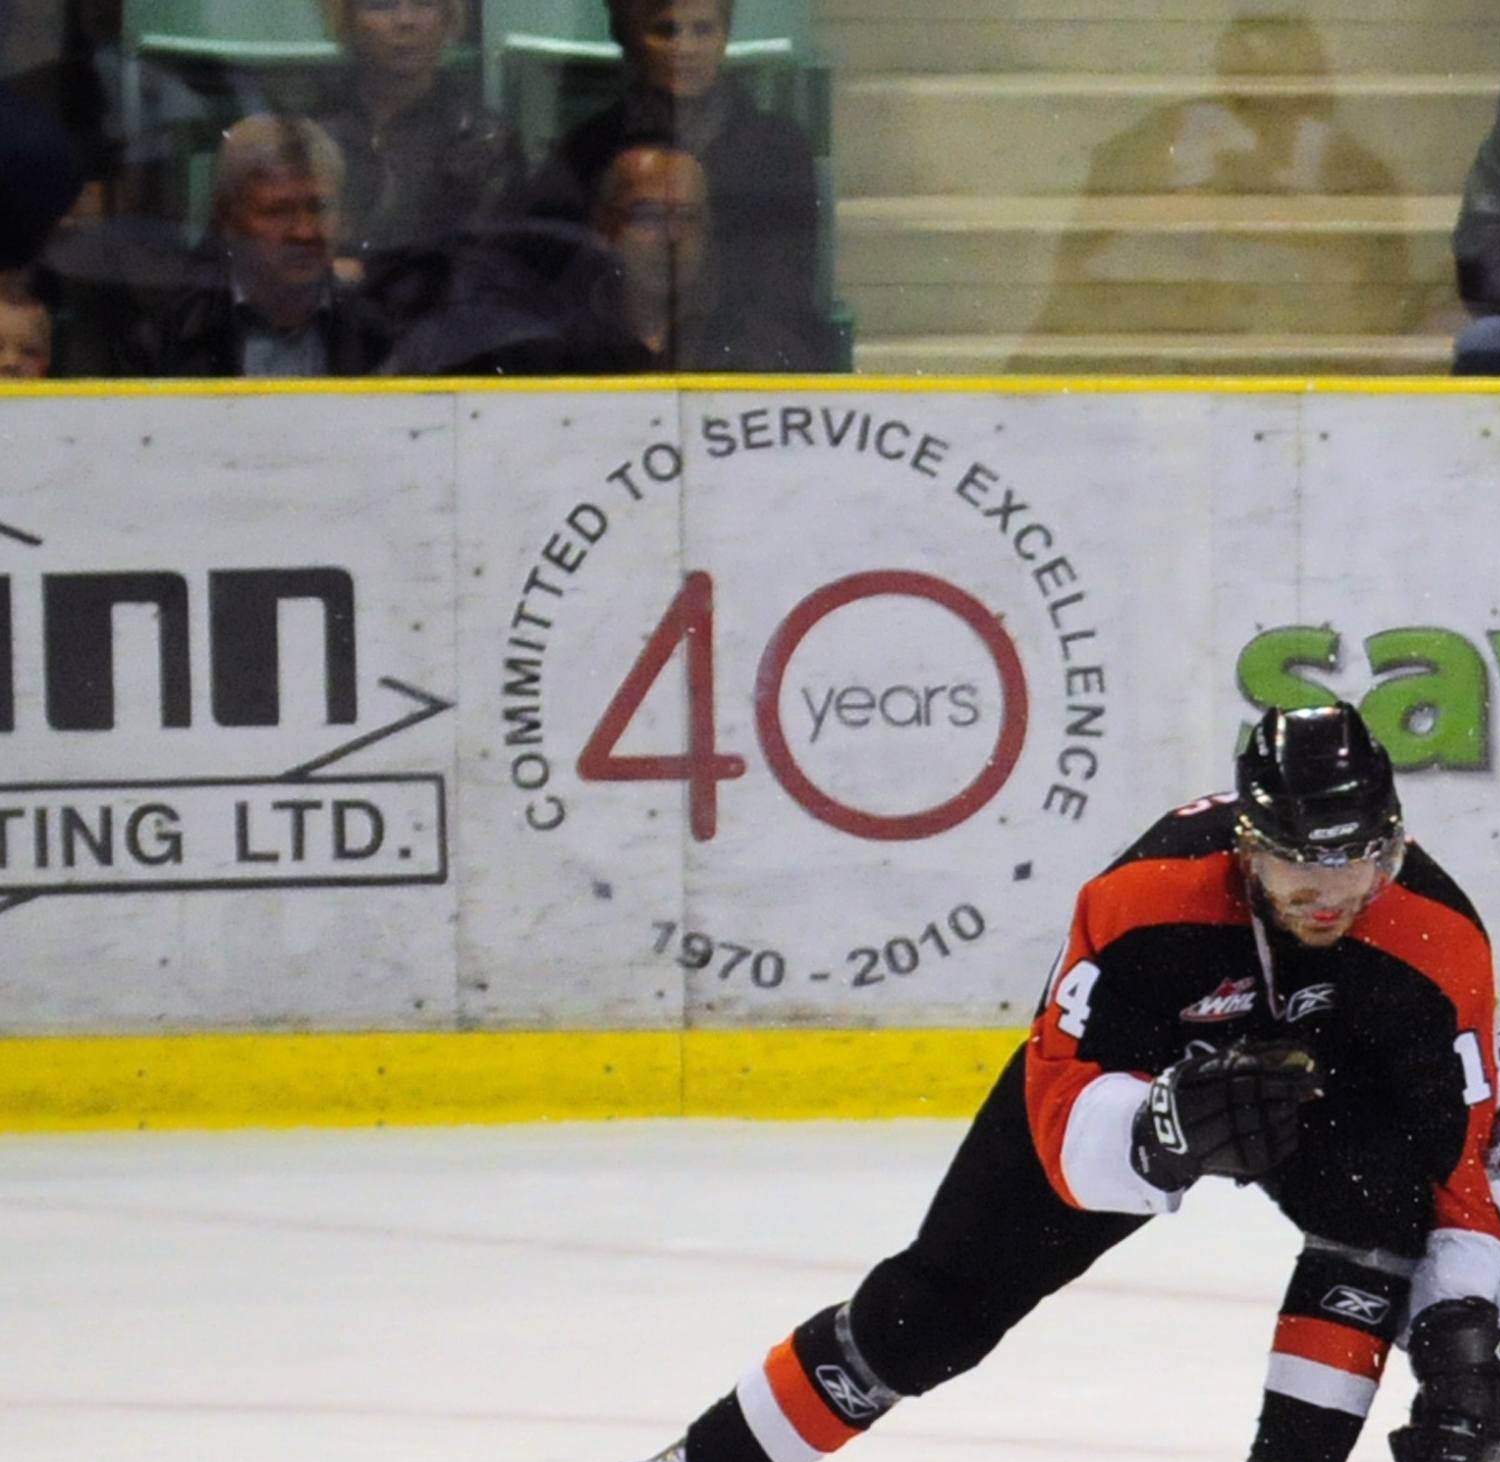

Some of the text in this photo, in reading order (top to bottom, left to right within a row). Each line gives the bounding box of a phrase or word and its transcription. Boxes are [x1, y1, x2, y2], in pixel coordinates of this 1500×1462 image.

[0, 567, 358, 733] nn
[502, 407, 1108, 834] COMMITTED TO SERVICE EXCELLENCE
[576, 569, 1030, 843] 40
[801, 684, 980, 744] years
[235, 800, 413, 863] LTD.
[650, 920, 786, 989] 1970
[846, 902, 987, 988] 2010
